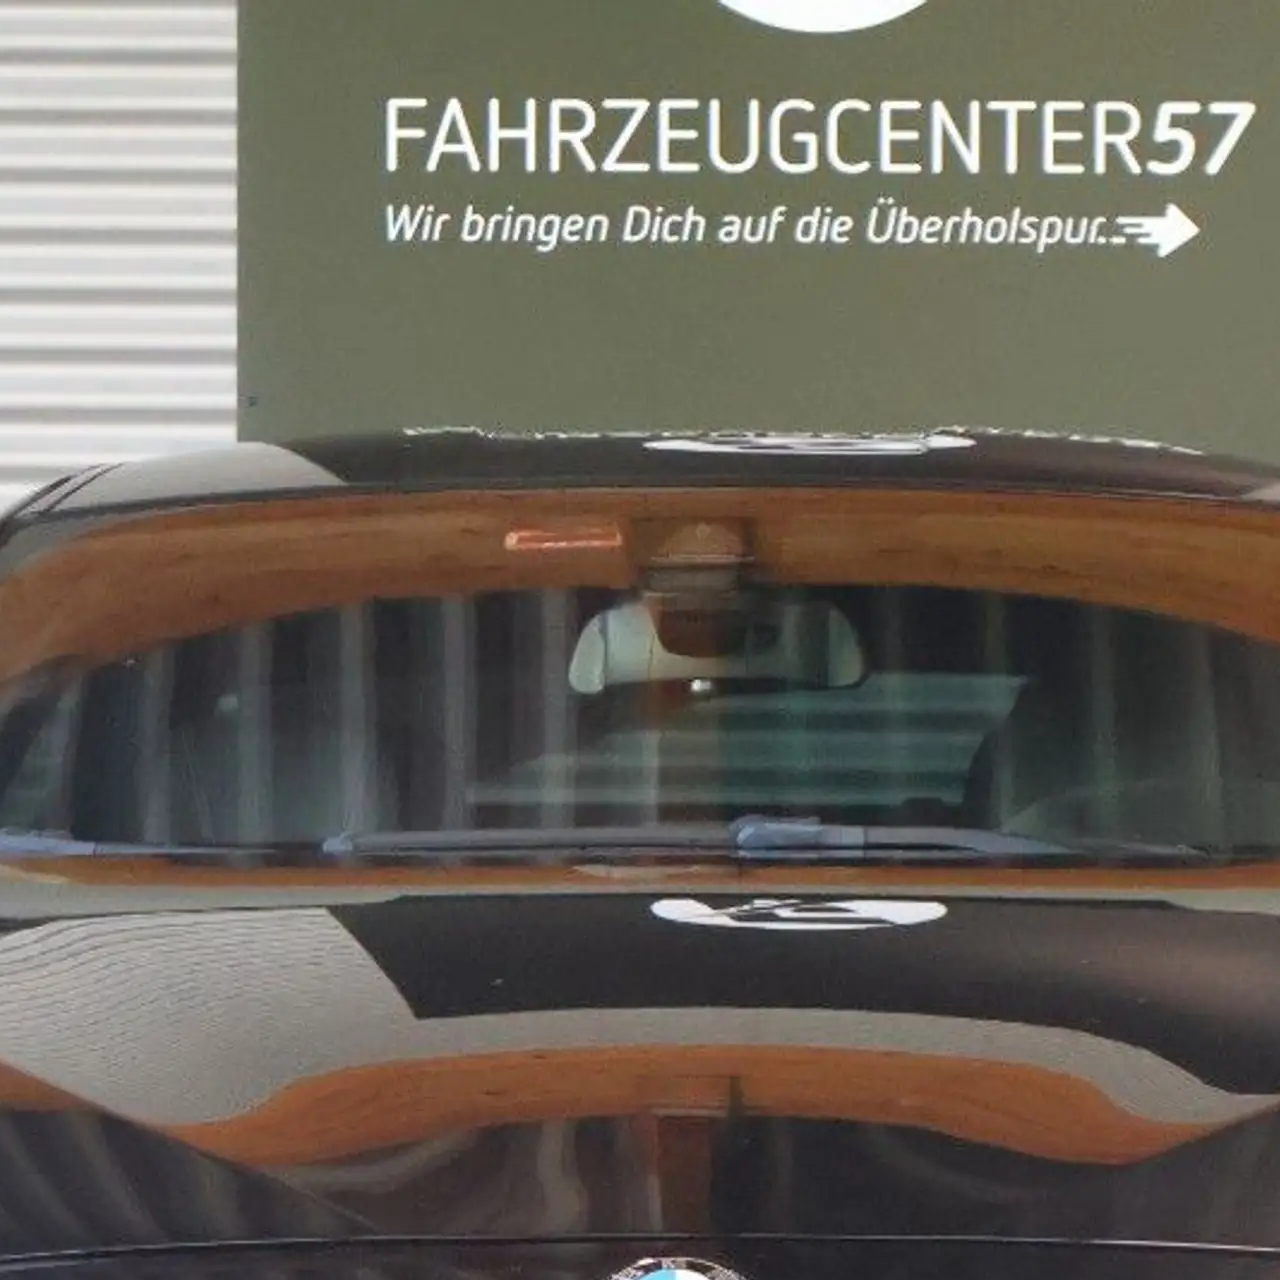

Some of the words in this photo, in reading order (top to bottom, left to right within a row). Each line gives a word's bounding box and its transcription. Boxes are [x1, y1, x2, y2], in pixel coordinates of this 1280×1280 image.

[384, 97, 1257, 177] FAHRZEUGCENTER57
[385, 203, 450, 243] Wir
[460, 204, 610, 253] bringen
[622, 204, 706, 244] Dich
[717, 205, 787, 245] auf
[794, 206, 854, 245] die
